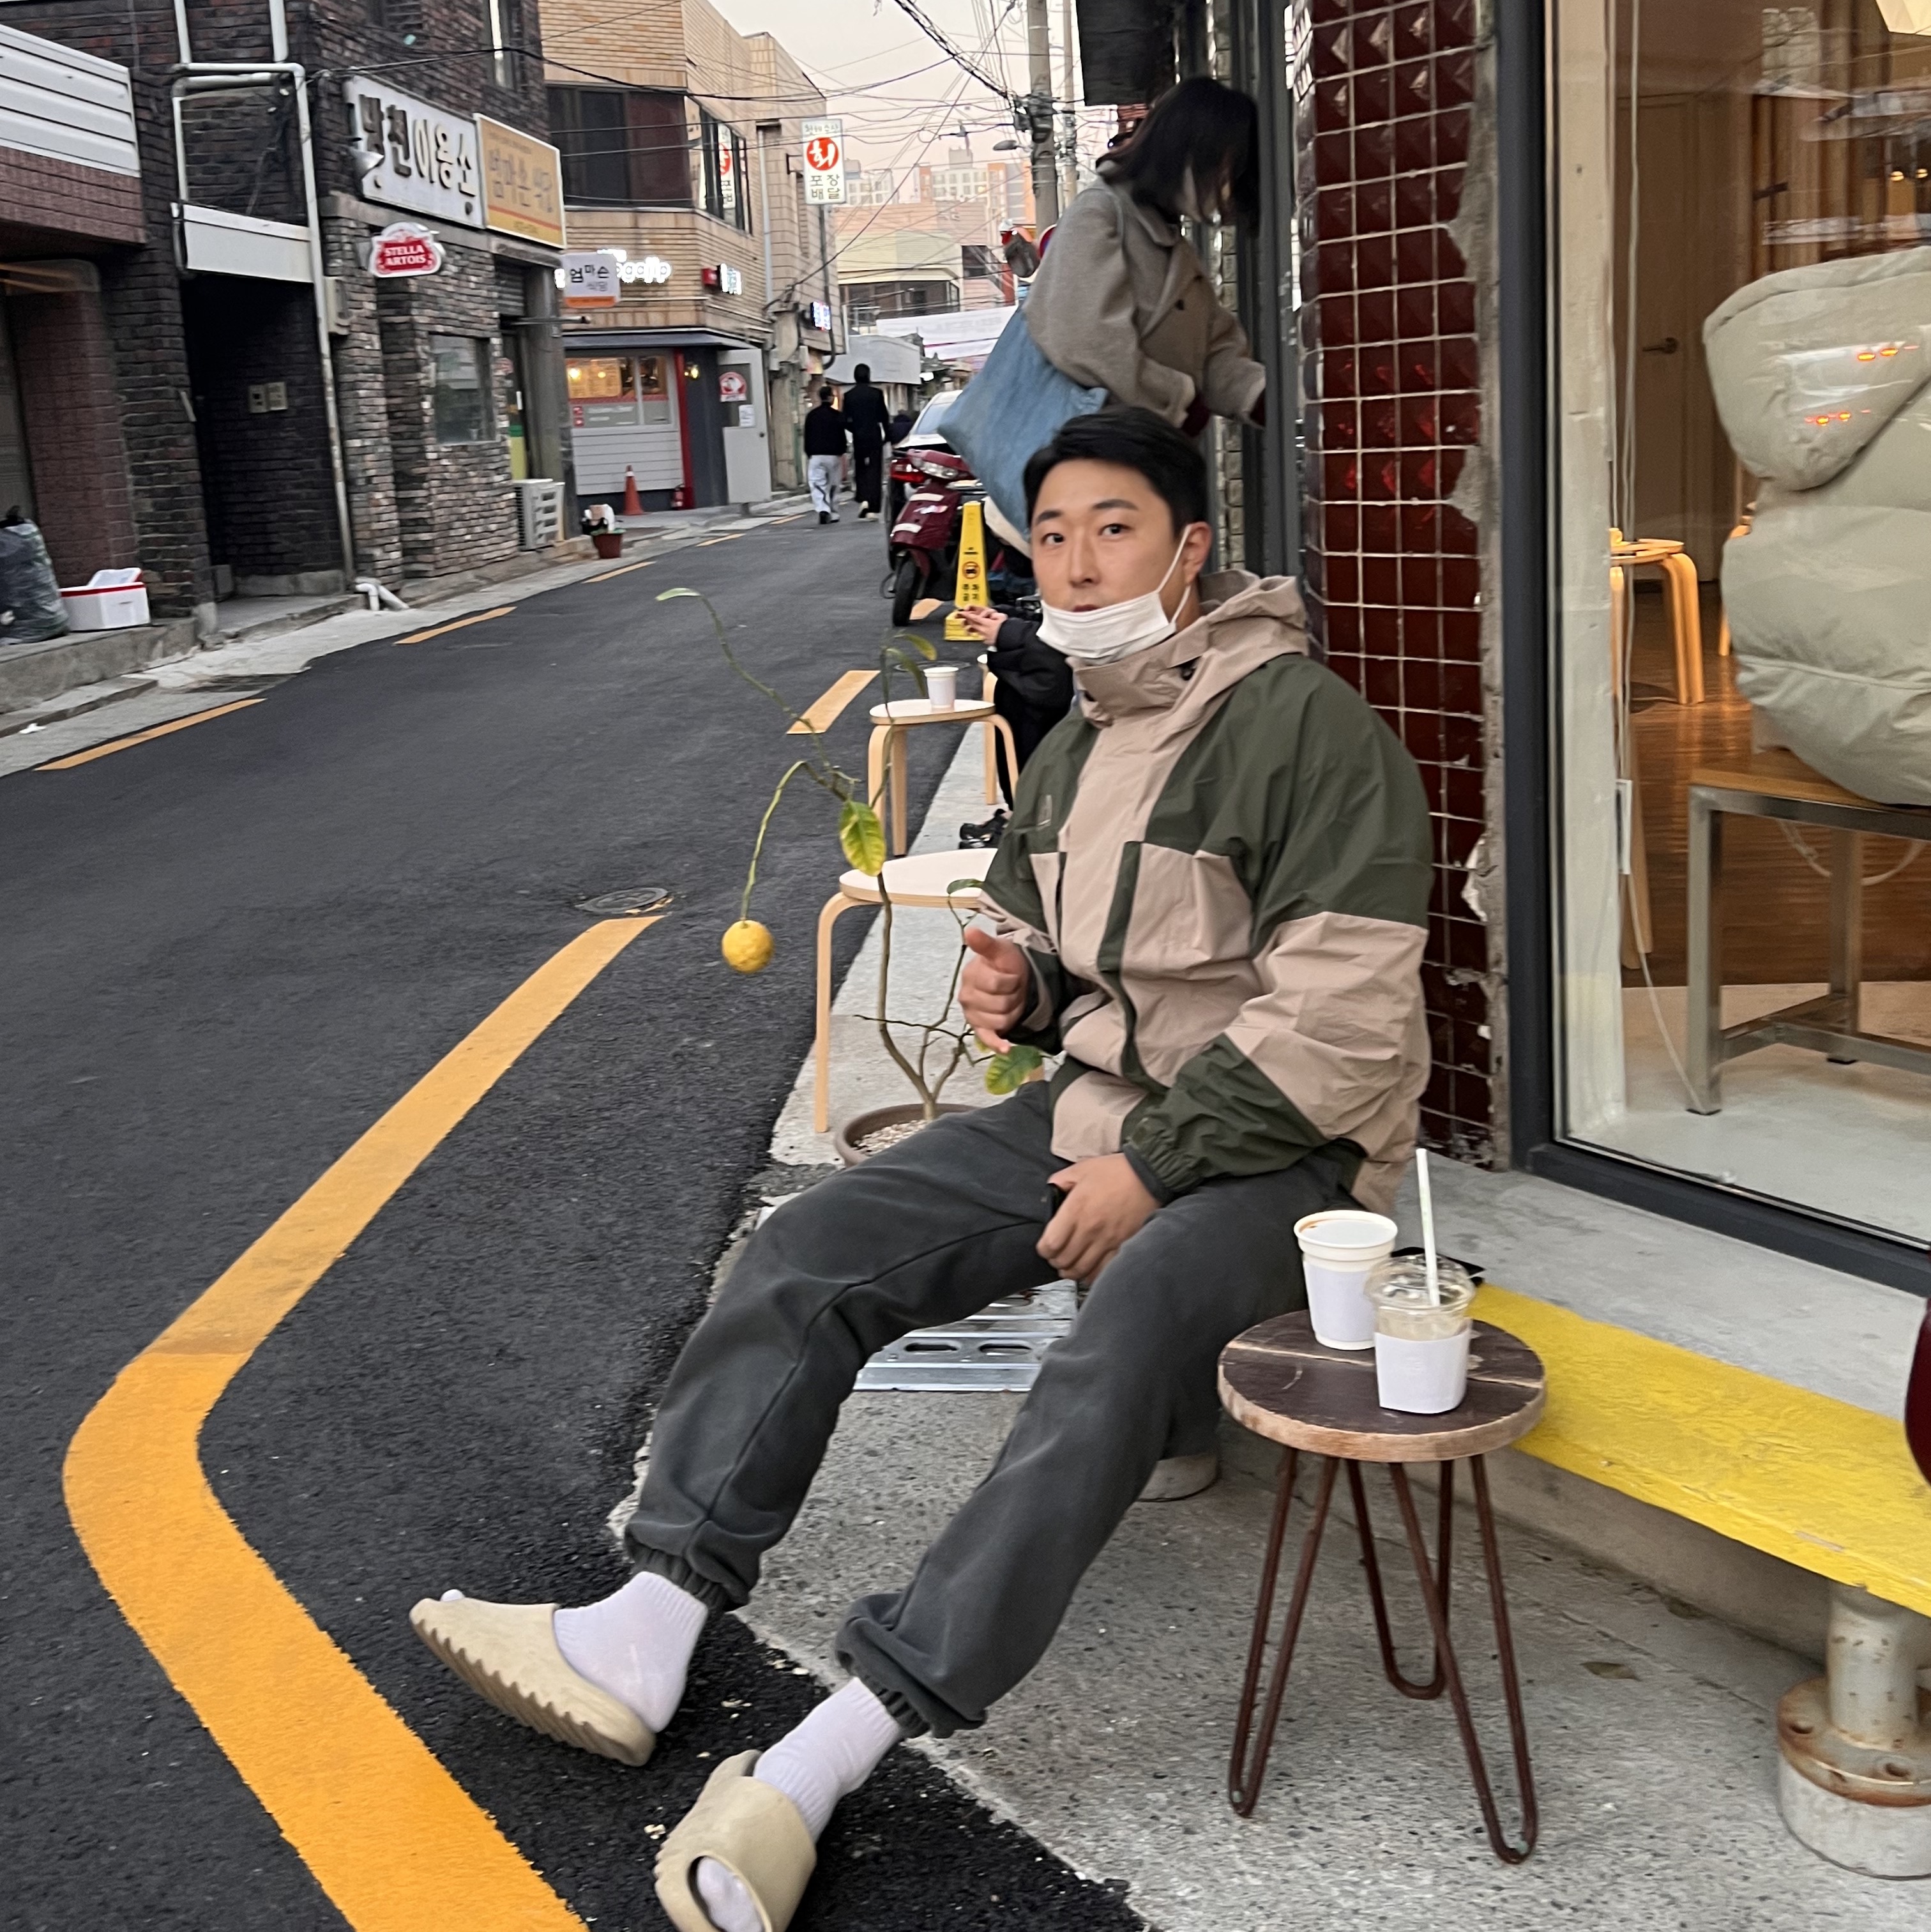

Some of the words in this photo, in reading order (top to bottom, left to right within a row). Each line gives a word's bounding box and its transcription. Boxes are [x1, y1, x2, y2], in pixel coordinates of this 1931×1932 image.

[810, 174, 840, 186] 포장
[812, 188, 840, 199] 배달
[385, 245, 425, 256] STELLA
[386, 255, 427, 266] ARTOIS
[570, 264, 610, 283] 엄마손
